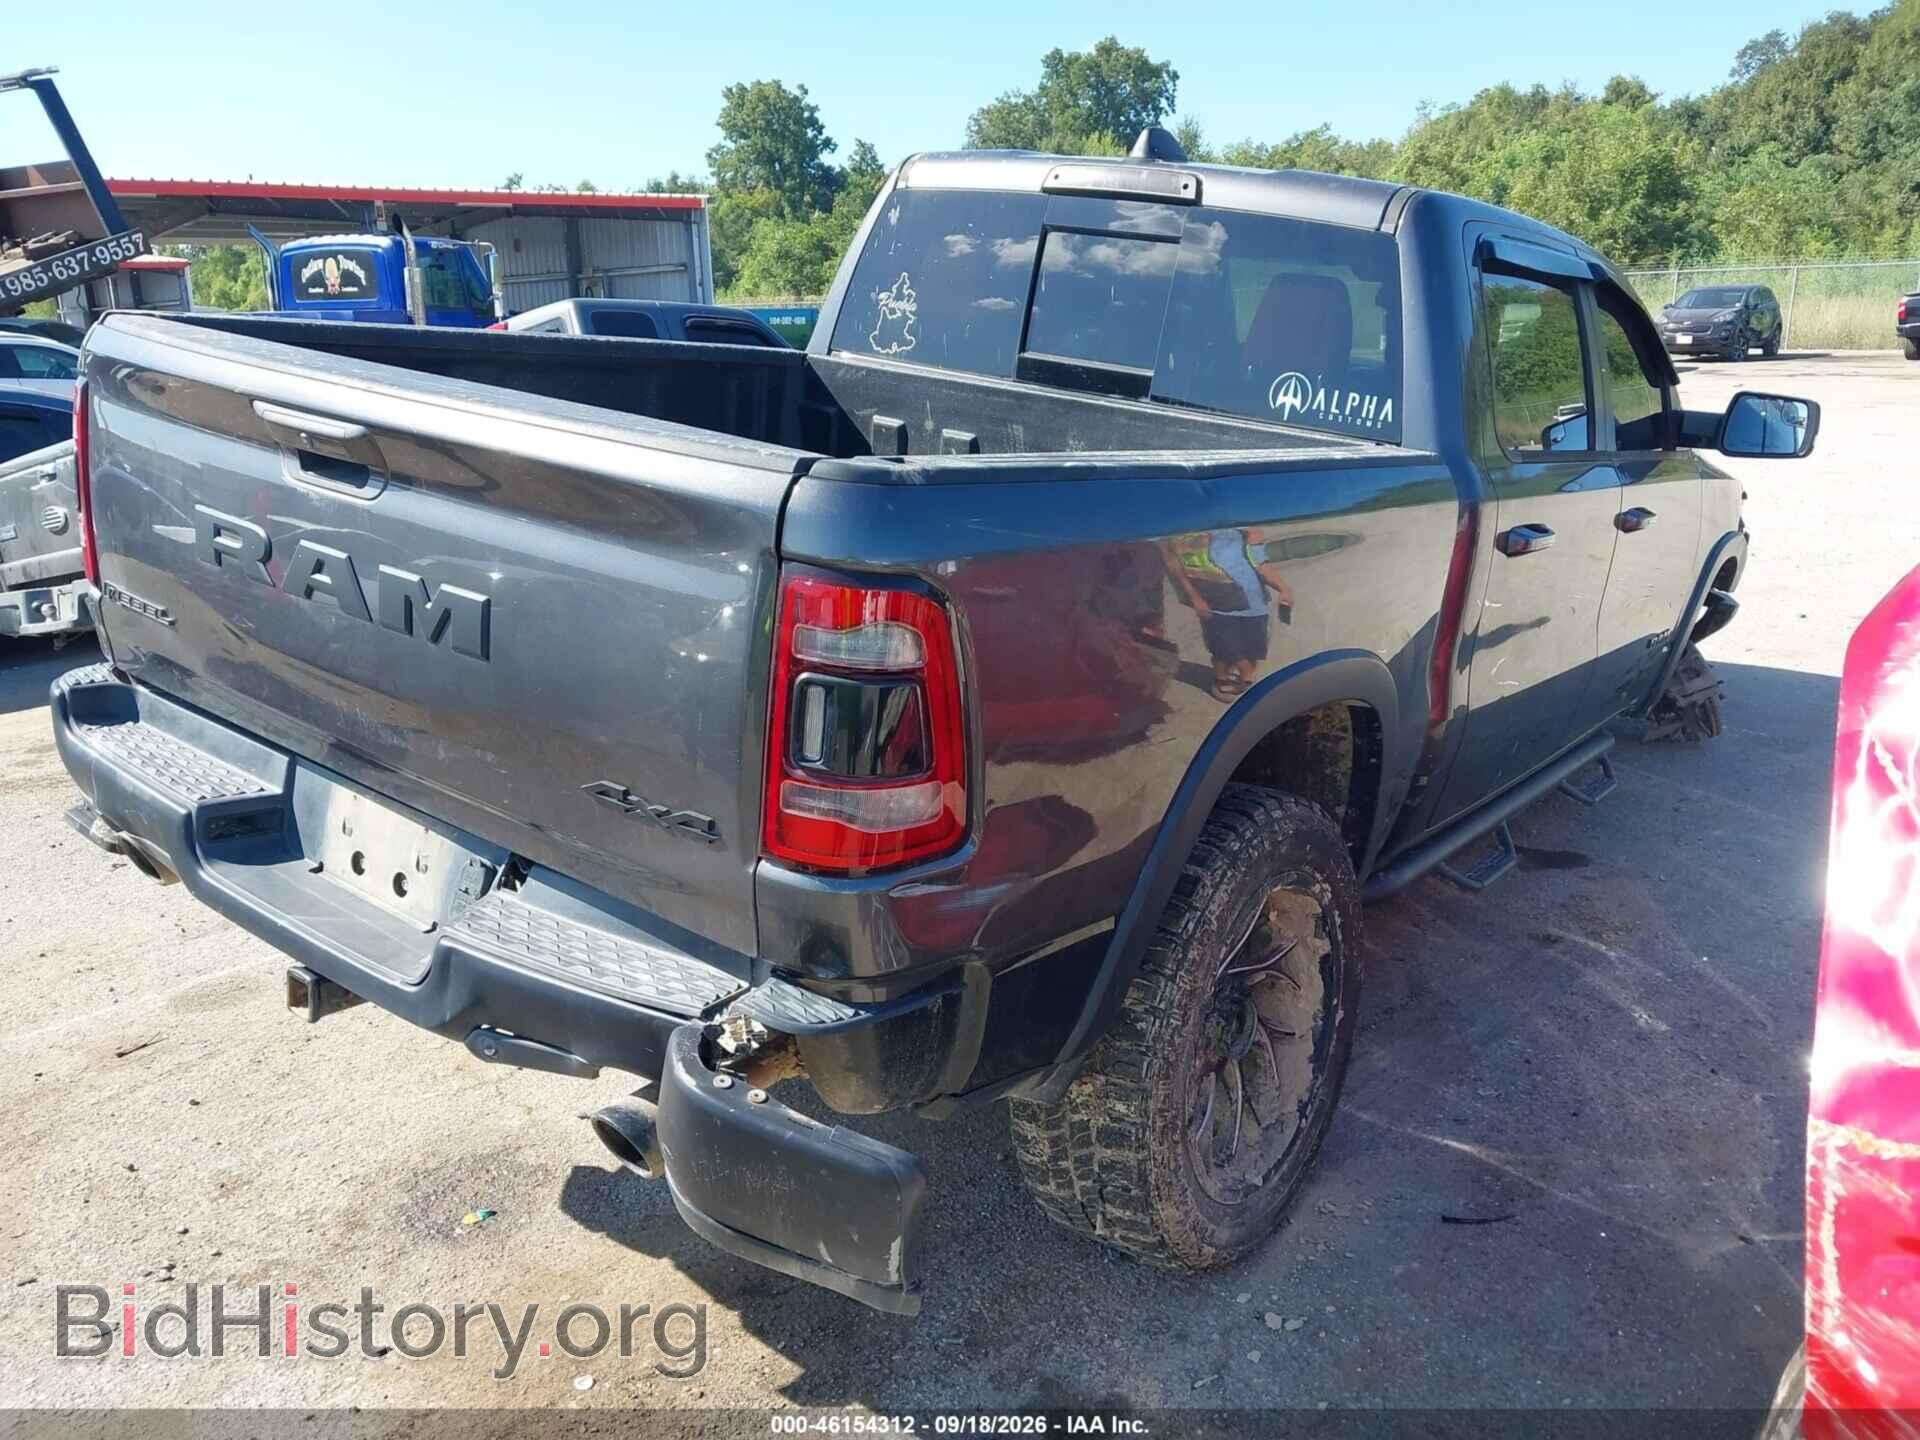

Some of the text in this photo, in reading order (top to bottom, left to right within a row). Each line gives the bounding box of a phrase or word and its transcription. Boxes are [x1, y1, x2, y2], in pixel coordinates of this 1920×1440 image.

[1312, 388, 1393, 422] ALPHA
[103, 580, 176, 628] REBEL
[194, 503, 491, 662] RAM
